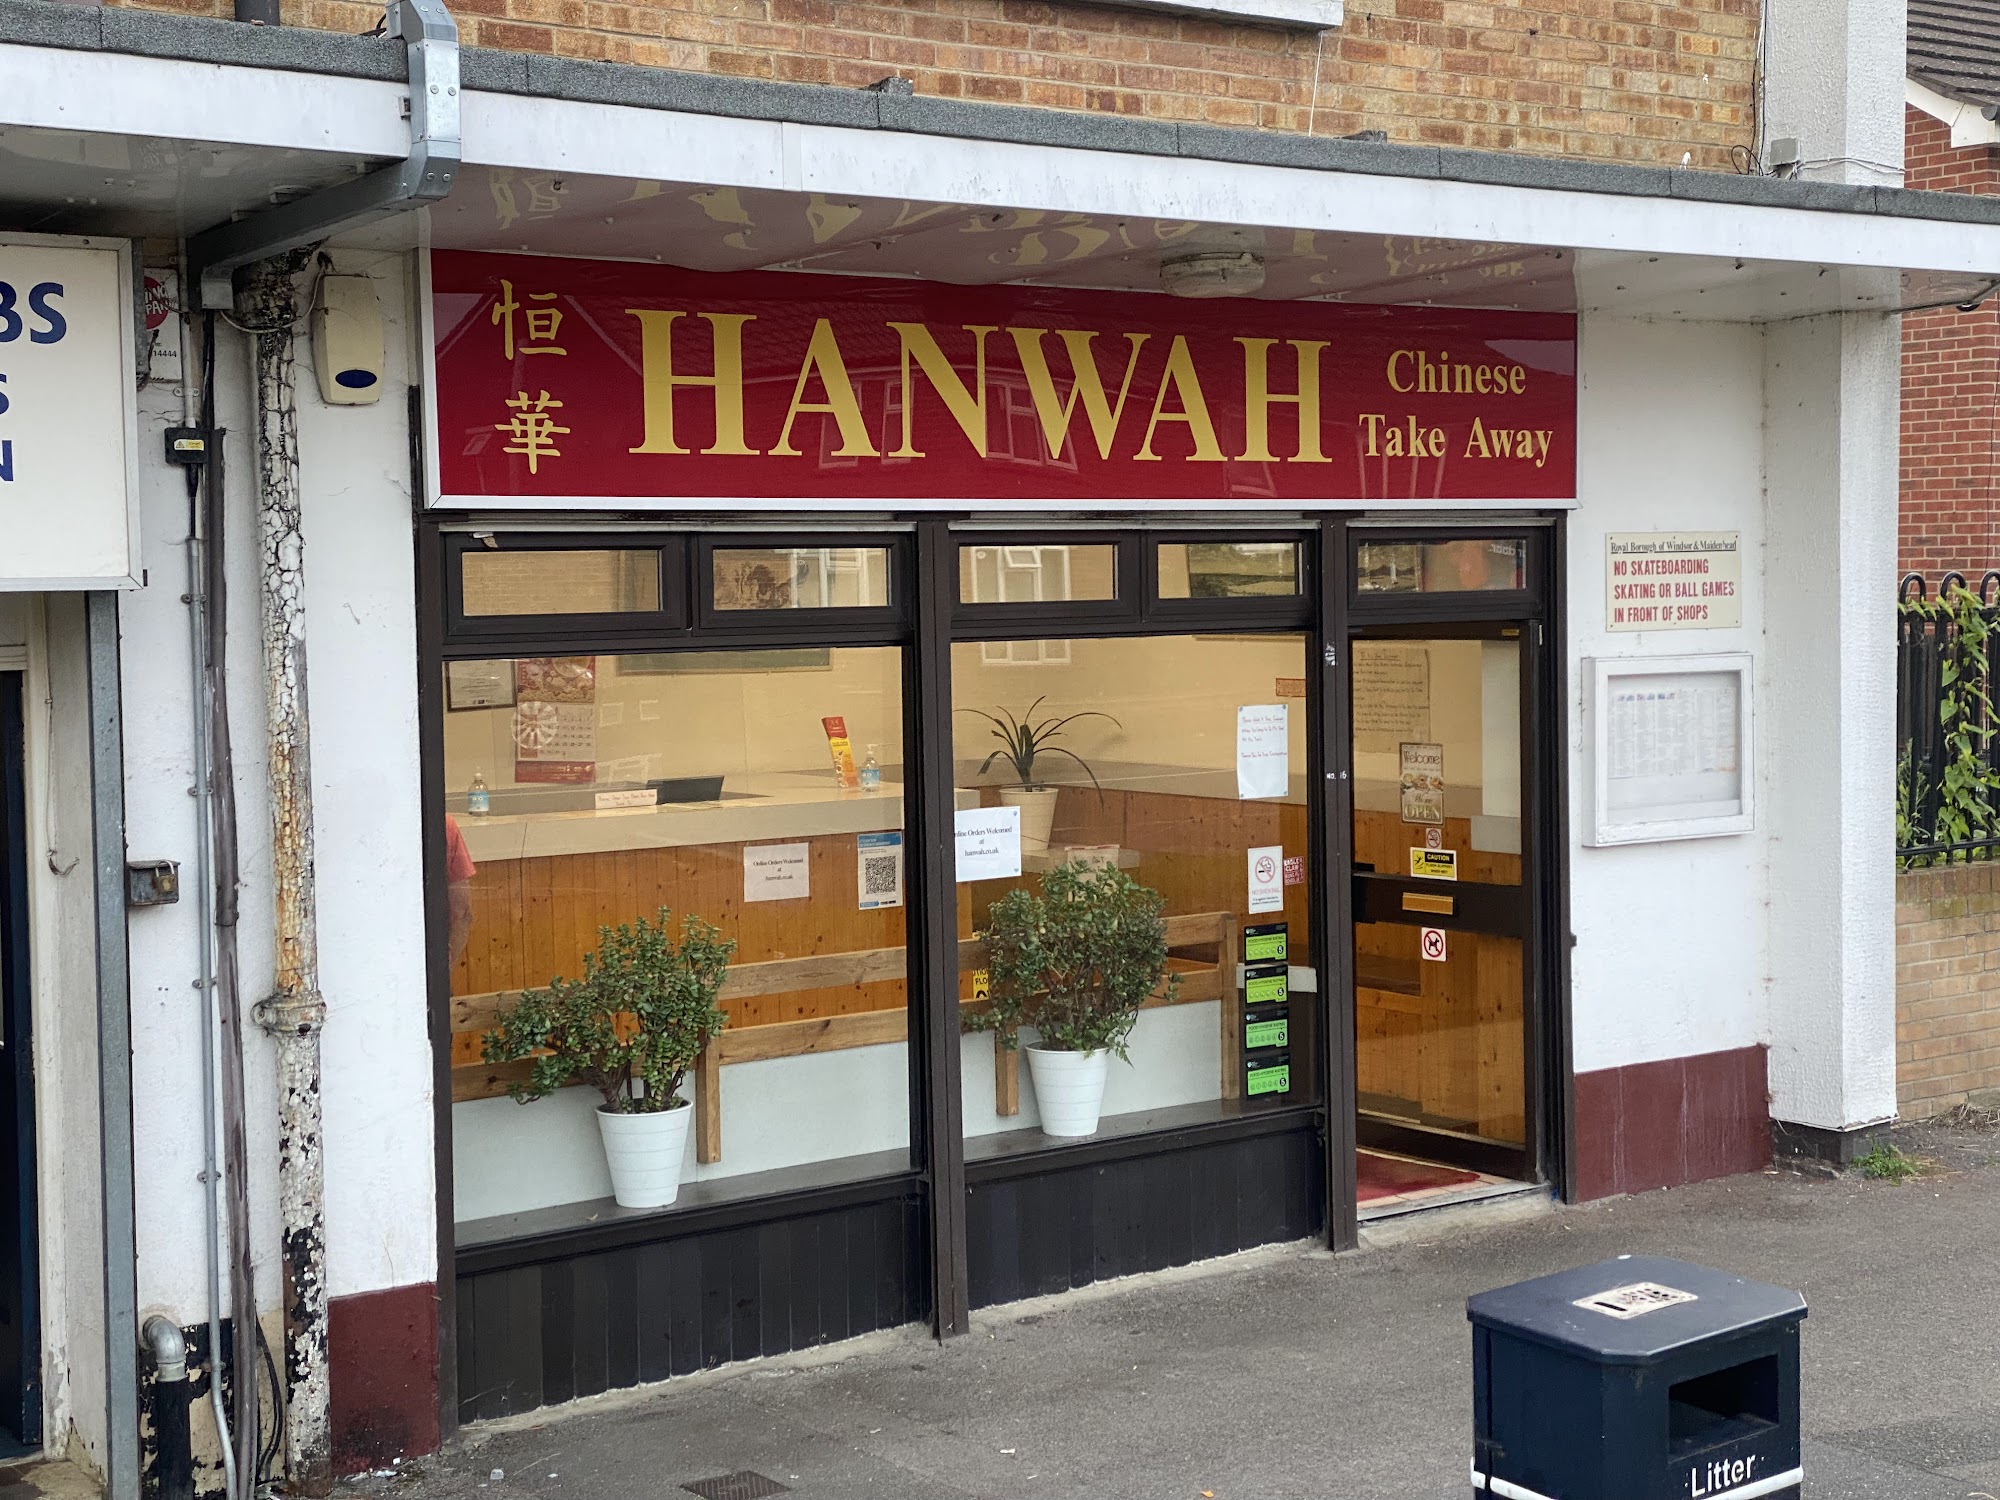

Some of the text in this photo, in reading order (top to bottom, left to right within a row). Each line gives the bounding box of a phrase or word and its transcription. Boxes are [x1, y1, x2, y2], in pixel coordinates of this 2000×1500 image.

[1386, 350, 1526, 395] Chinese
[625, 308, 1332, 462] HANWAH
[1359, 414, 1553, 469] Take Away
[1611, 540, 1736, 553] Royal Borough of Windsor & Maidenhead
[1614, 559, 1709, 576] NO SKATEBOARDING
[1615, 581, 1735, 600] SKATING OR BALL GAMES
[1615, 605, 1708, 623] IN FRONT OF SHOPS
[1404, 751, 1440, 764] Welcome
[1405, 805, 1440, 820] OPEN
[968, 829, 986, 837] Orders
[986, 826, 1013, 834] Welcomed
[965, 847, 999, 857] hanwah.co.uk
[1427, 853, 1450, 862] CAUTION
[1690, 1454, 1757, 1498] Litter
